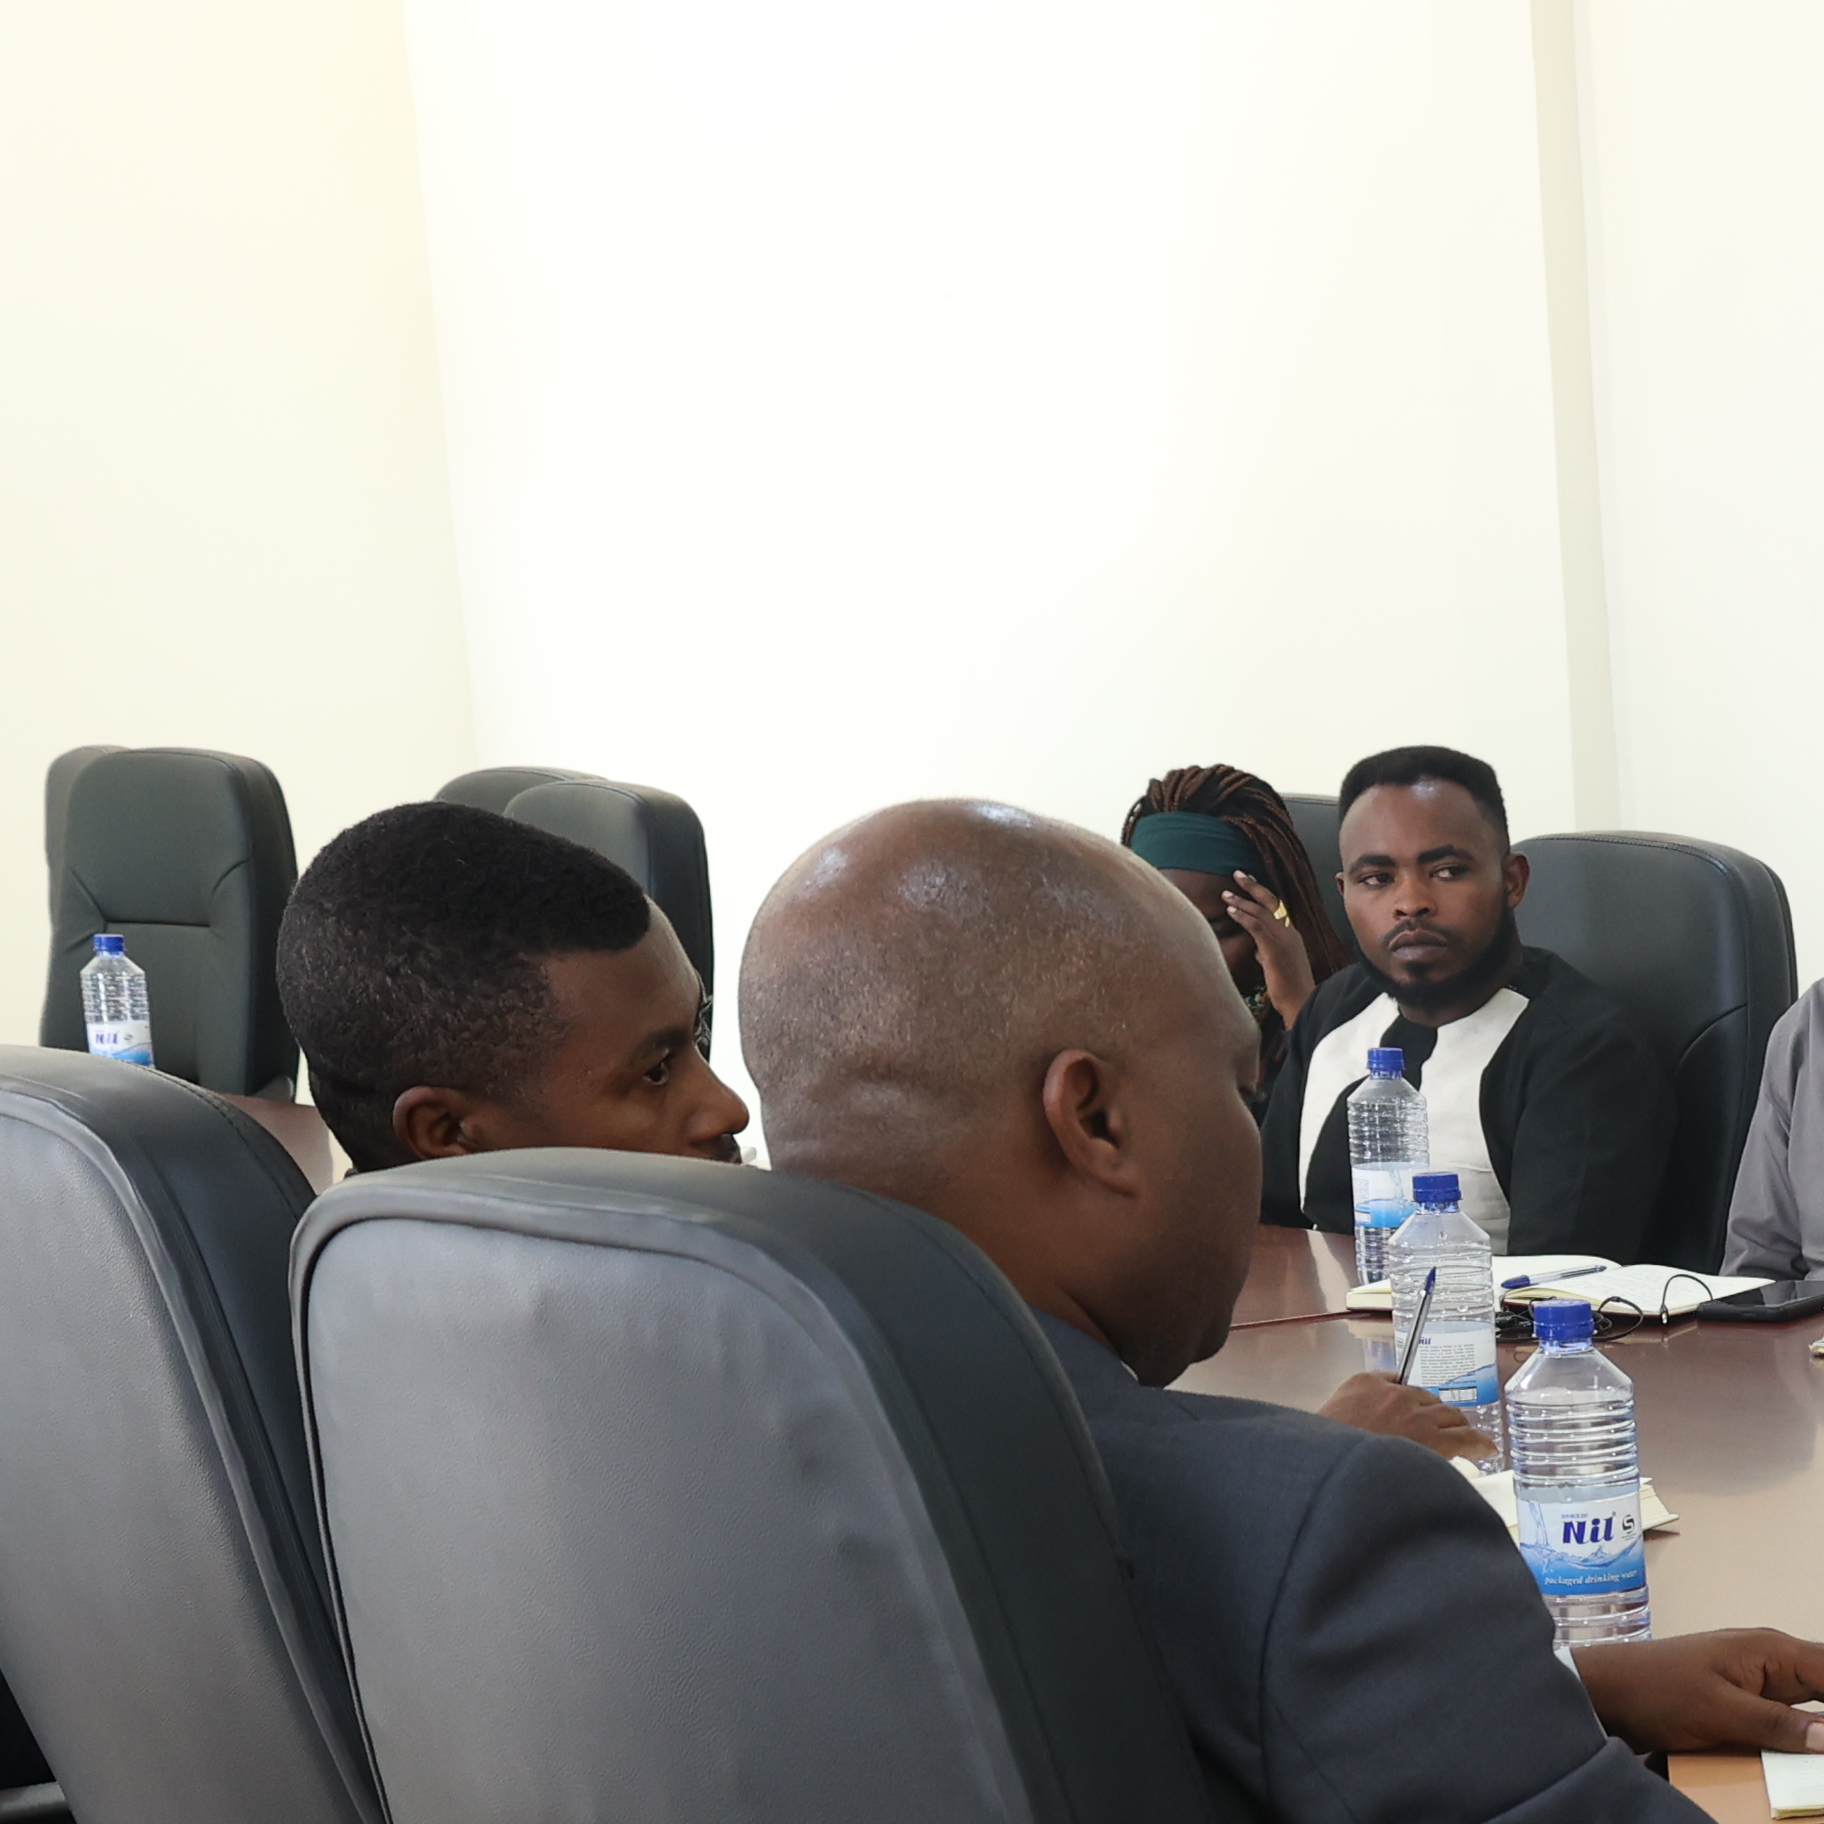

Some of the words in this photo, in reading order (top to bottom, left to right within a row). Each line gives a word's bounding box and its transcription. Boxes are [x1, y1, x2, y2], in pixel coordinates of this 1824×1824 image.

[1562, 1516, 1615, 1545] Nil
[1545, 1575, 1584, 1586] packaged
[1584, 1573, 1620, 1585] drinking
